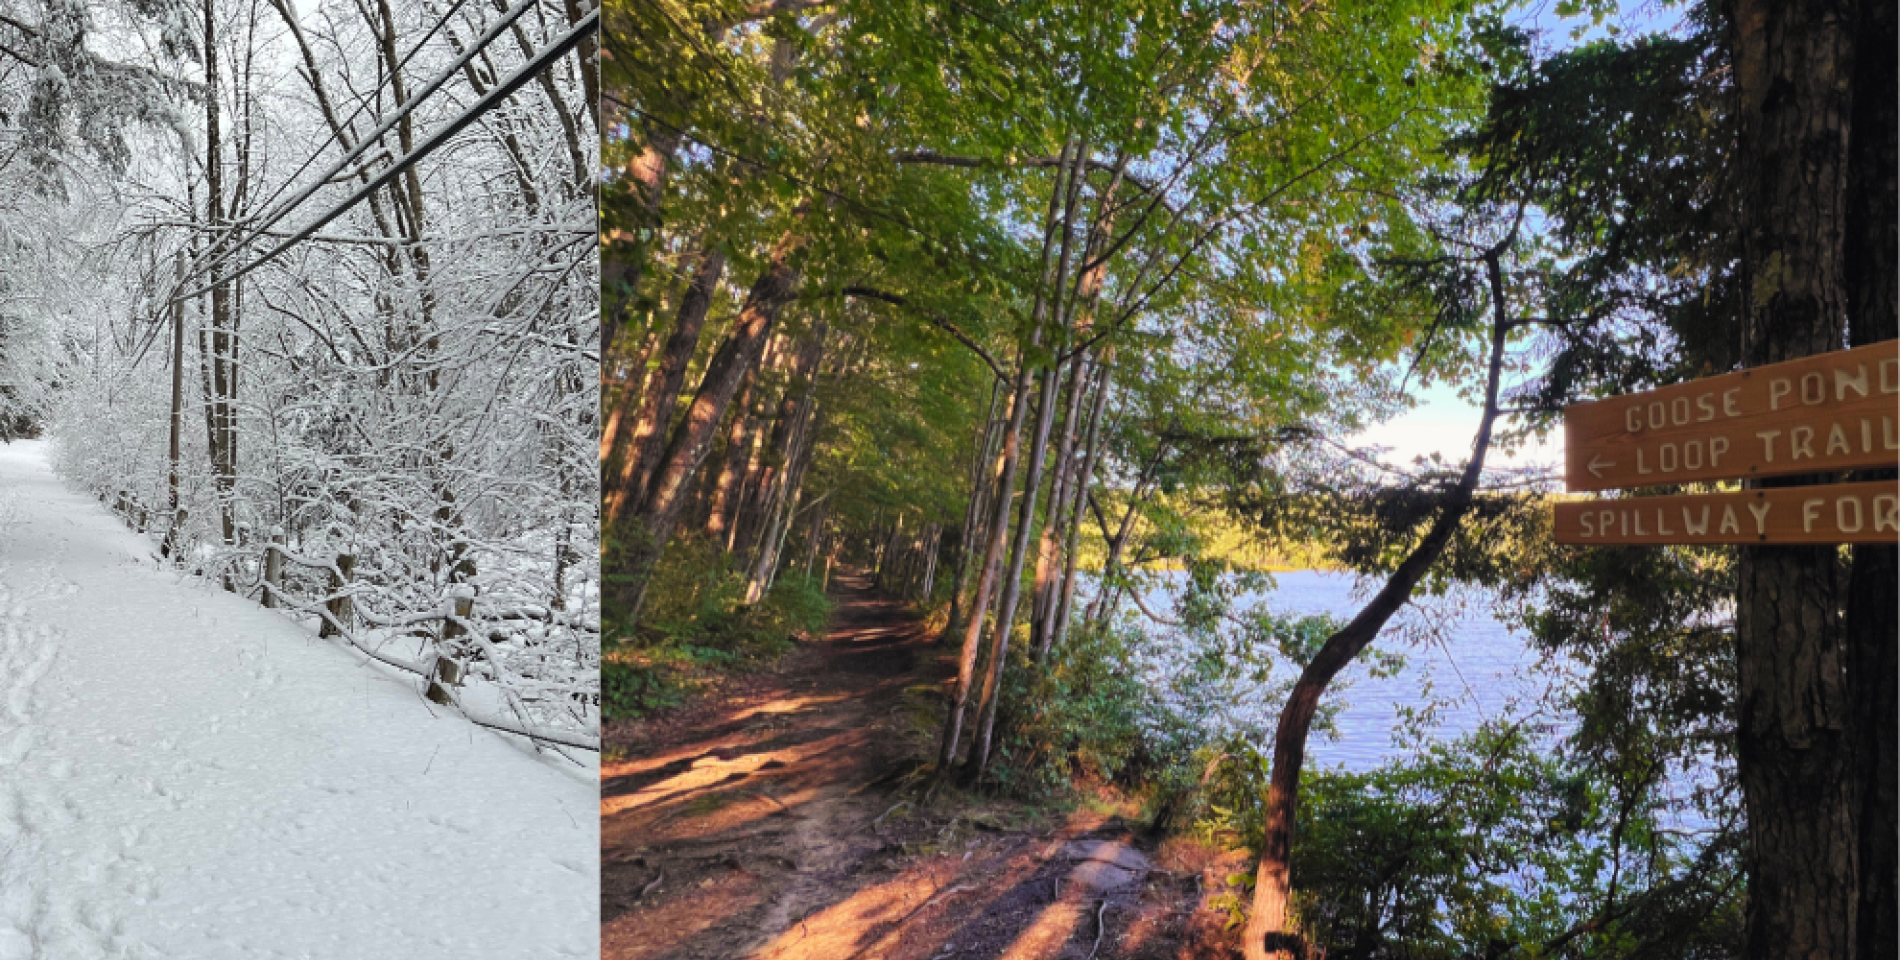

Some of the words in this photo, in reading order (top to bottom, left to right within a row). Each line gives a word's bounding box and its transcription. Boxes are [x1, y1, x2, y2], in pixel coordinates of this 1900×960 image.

[1626, 387, 1742, 432] GOOSE
[1636, 436, 1730, 475] LOOP
[1756, 415, 1899, 463] TRAIL
[1579, 502, 1771, 537] SPILLWAY
